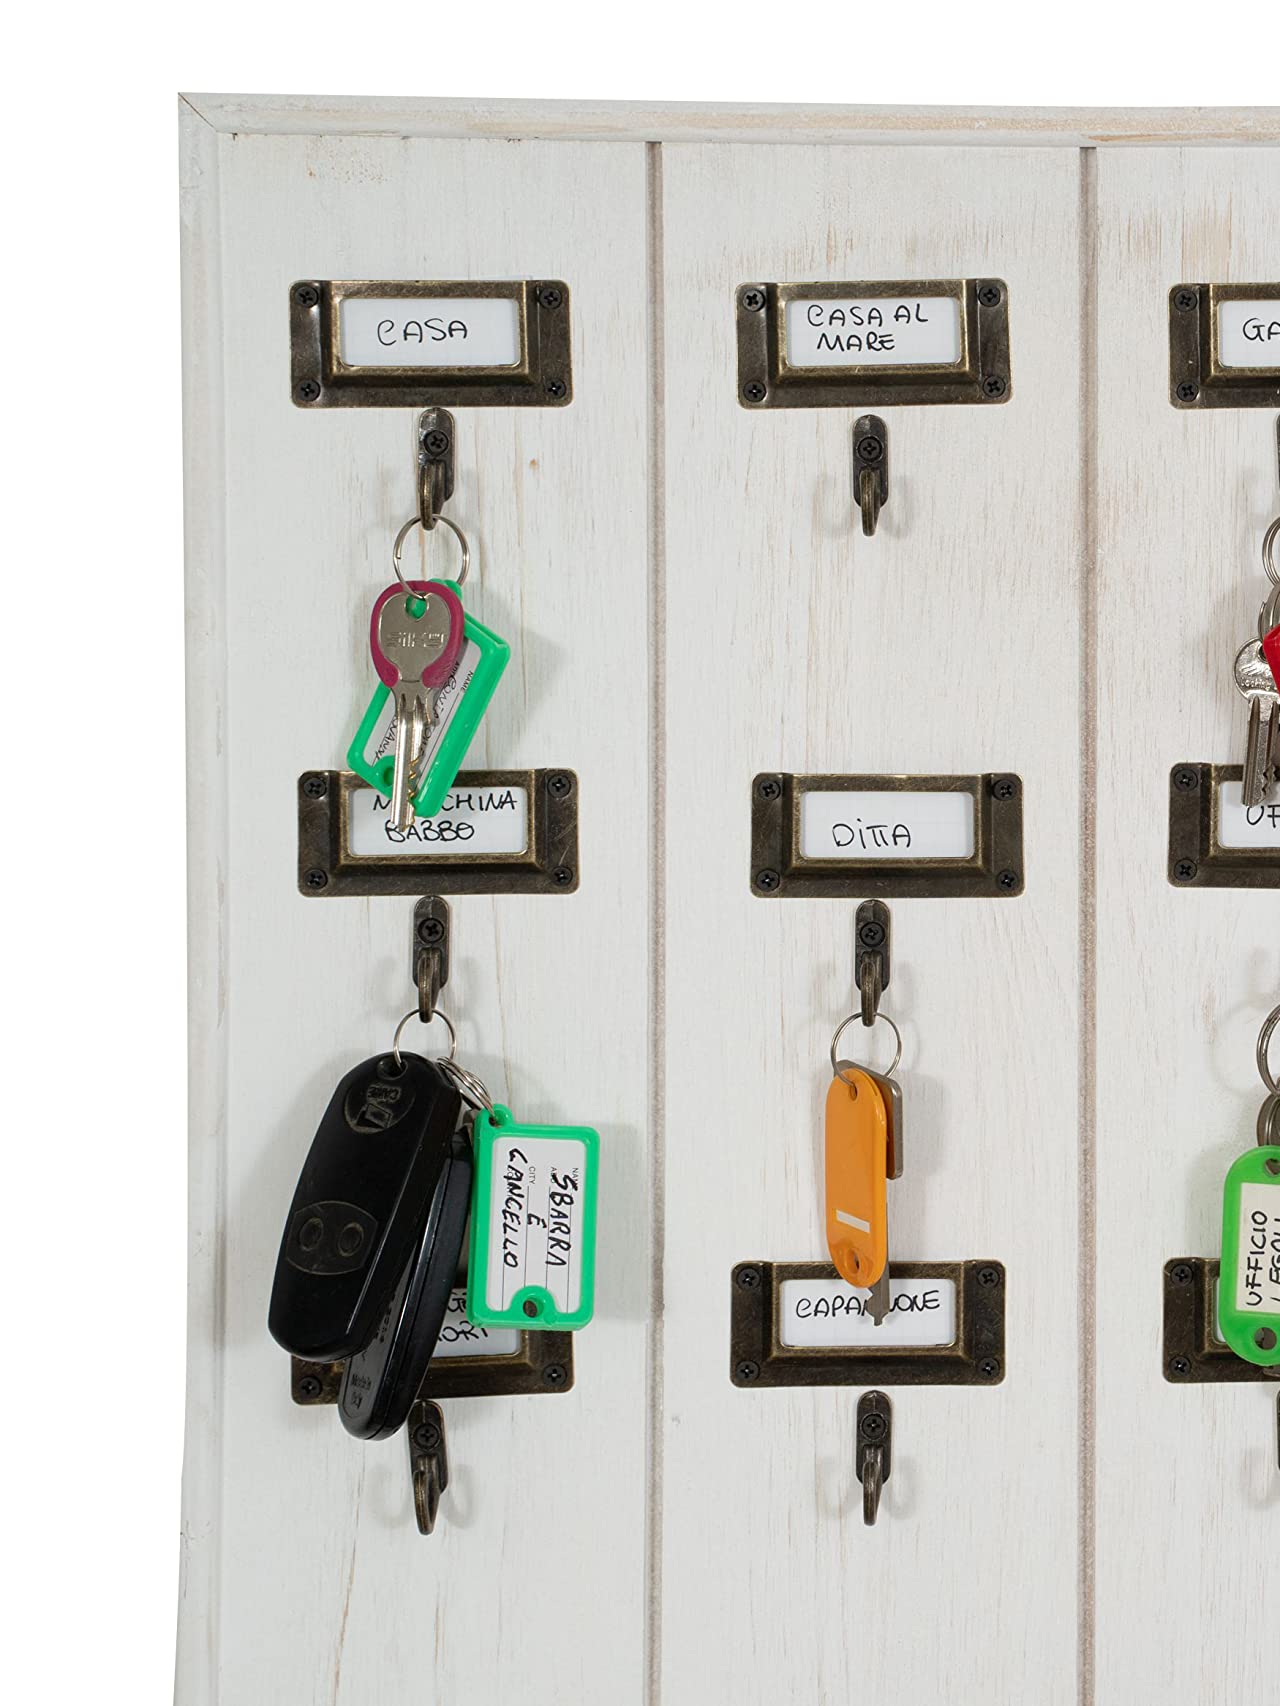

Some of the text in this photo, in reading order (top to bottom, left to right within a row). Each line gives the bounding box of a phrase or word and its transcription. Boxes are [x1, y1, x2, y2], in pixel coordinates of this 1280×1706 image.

[807, 303, 929, 327] CASA AL
[377, 317, 468, 346] CASA
[816, 331, 896, 352] MARE
[373, 790, 518, 812] MCHINA
[385, 819, 475, 843] BABBO
[528, 1166, 536, 1185] CITY
[501, 1148, 529, 1268] CANCELLO
[545, 1174, 579, 1267] SBARRA
[1245, 1210, 1268, 1306] UFFICIO
